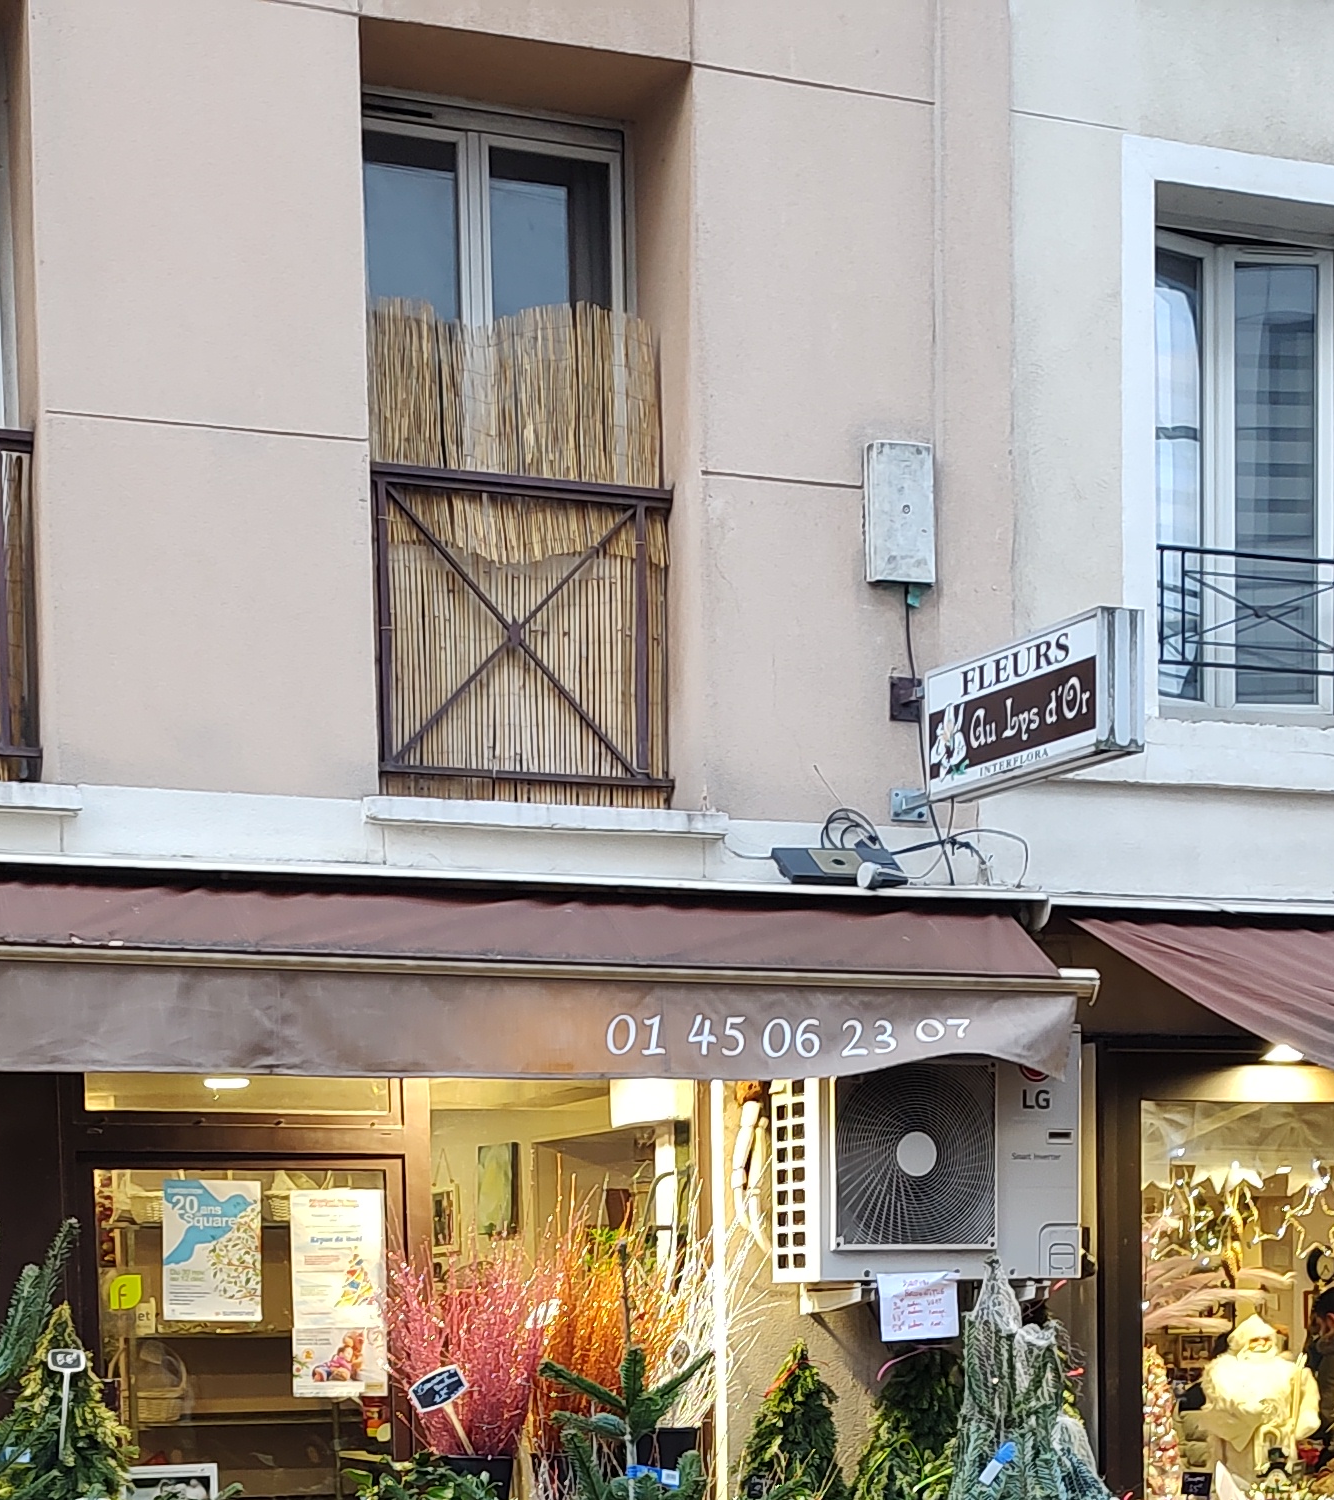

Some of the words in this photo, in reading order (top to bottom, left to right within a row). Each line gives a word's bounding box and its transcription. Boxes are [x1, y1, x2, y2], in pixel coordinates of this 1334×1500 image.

[960, 632, 1071, 698] FLEURS
[1001, 697, 1040, 742] Lys
[1044, 676, 1091, 726] d'Or
[979, 748, 1050, 778] INTERFLORA
[605, 1012, 668, 1057] 01
[686, 1013, 748, 1058] 45
[761, 1017, 822, 1059] 06
[840, 1019, 898, 1058] 23
[915, 1018, 971, 1042] 07
[1022, 1088, 1051, 1110] LG
[171, 1195, 199, 1214] 20
[200, 1205, 222, 1215] ans
[183, 1213, 237, 1230] Square
